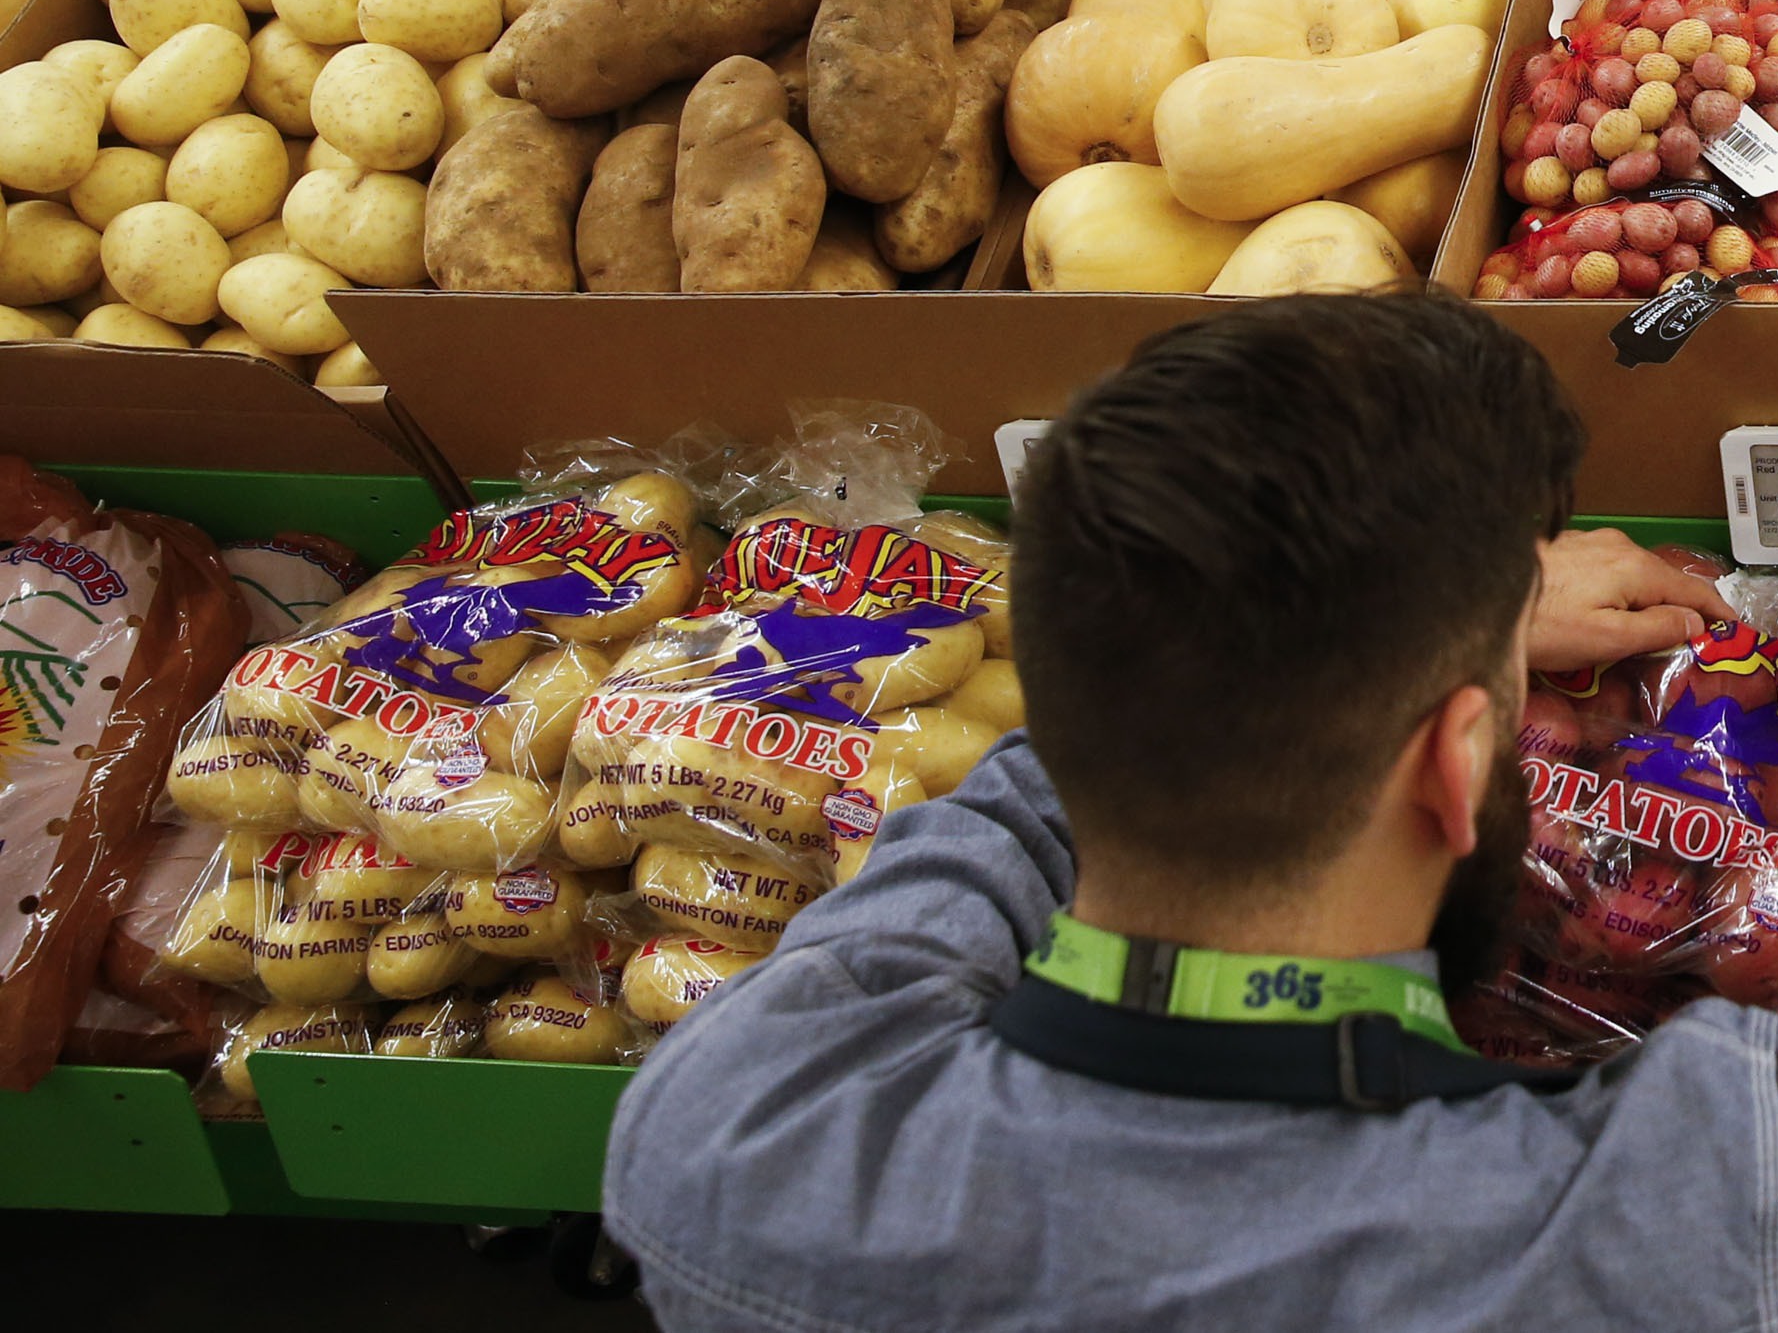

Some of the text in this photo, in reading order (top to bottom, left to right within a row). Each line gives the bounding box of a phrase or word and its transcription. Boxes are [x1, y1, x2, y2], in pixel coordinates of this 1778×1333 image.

[1756, 466, 1776, 474] Red
[652, 766, 662, 784] 5
[711, 776, 757, 802] 2.27
[761, 787, 786, 815] kg
[824, 807, 874, 829] GUARANTEED
[832, 802, 872, 819] NON GMO
[766, 828, 793, 844] CA
[755, 875, 789, 903] WT.
[794, 884, 808, 905] 5
[343, 898, 355, 916] 5
[639, 893, 739, 928] JOHNSTON
[300, 937, 369, 958] FARMS
[477, 924, 530, 940] 93220
[1243, 962, 1326, 1011] 365
[510, 1004, 587, 1029] CA 93220
